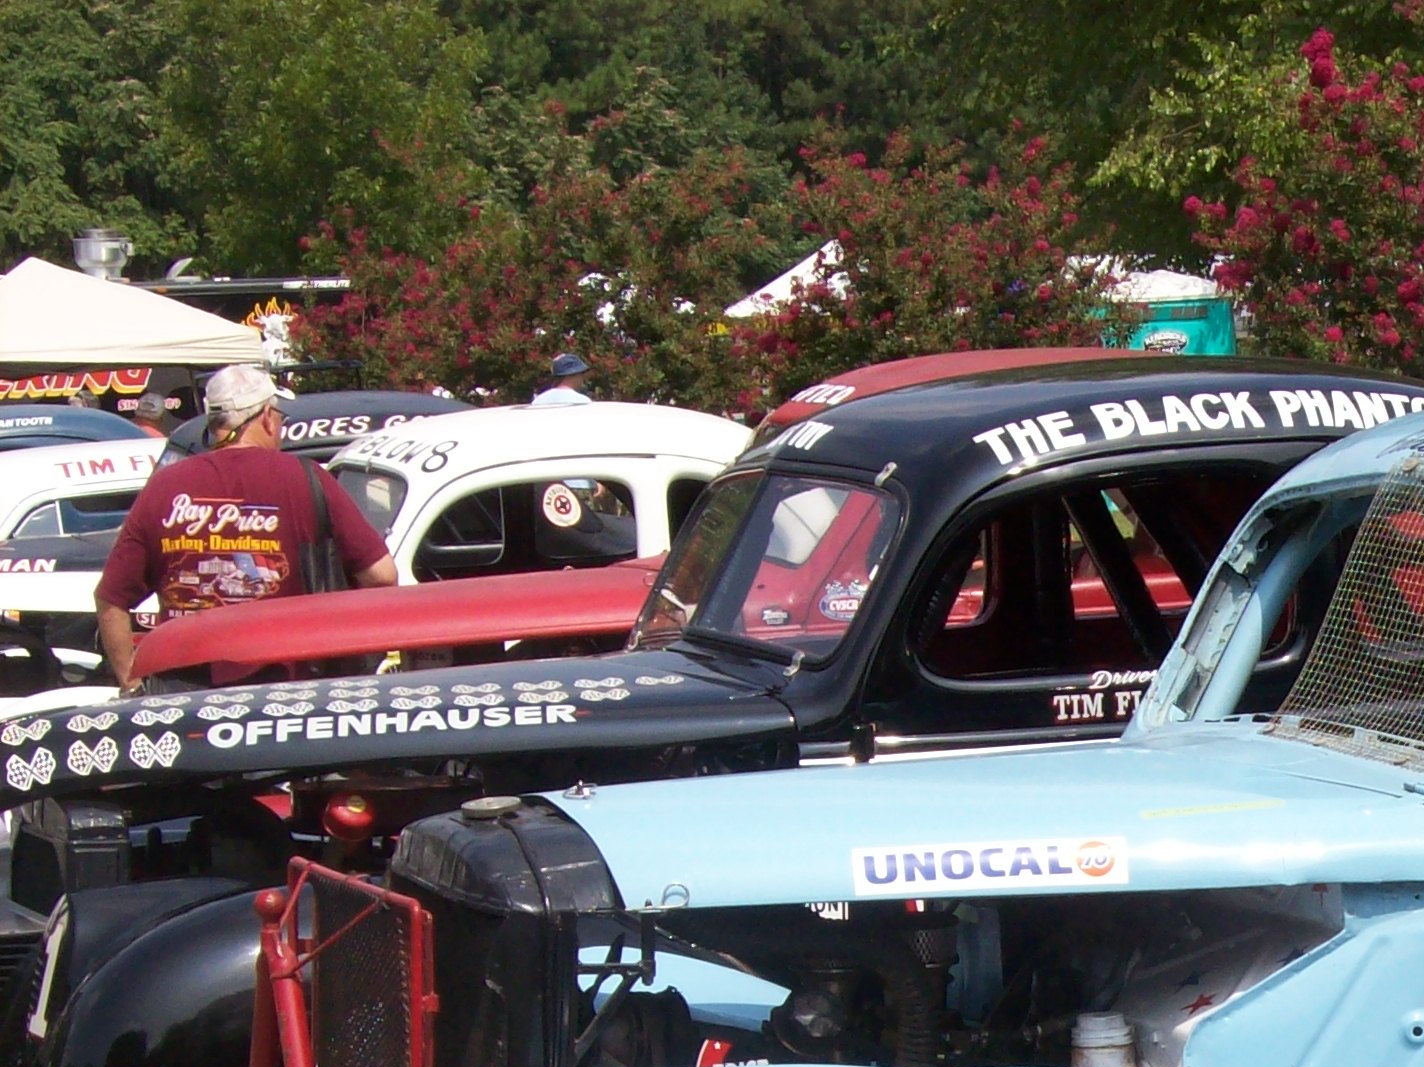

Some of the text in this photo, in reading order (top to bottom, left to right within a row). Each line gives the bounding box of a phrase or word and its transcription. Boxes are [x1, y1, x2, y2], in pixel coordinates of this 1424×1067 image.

[973, 411, 1088, 465] THE
[1090, 391, 1265, 441] BLACK
[54, 457, 115, 478] TIM
[421, 441, 458, 473] 8
[162, 494, 279, 535] Ray Price
[161, 535, 280, 553] Harley-Davidson
[1053, 693, 1104, 720] TIM
[207, 704, 577, 748] OFFENHAUSER
[863, 845, 1073, 885] UNOCAL
